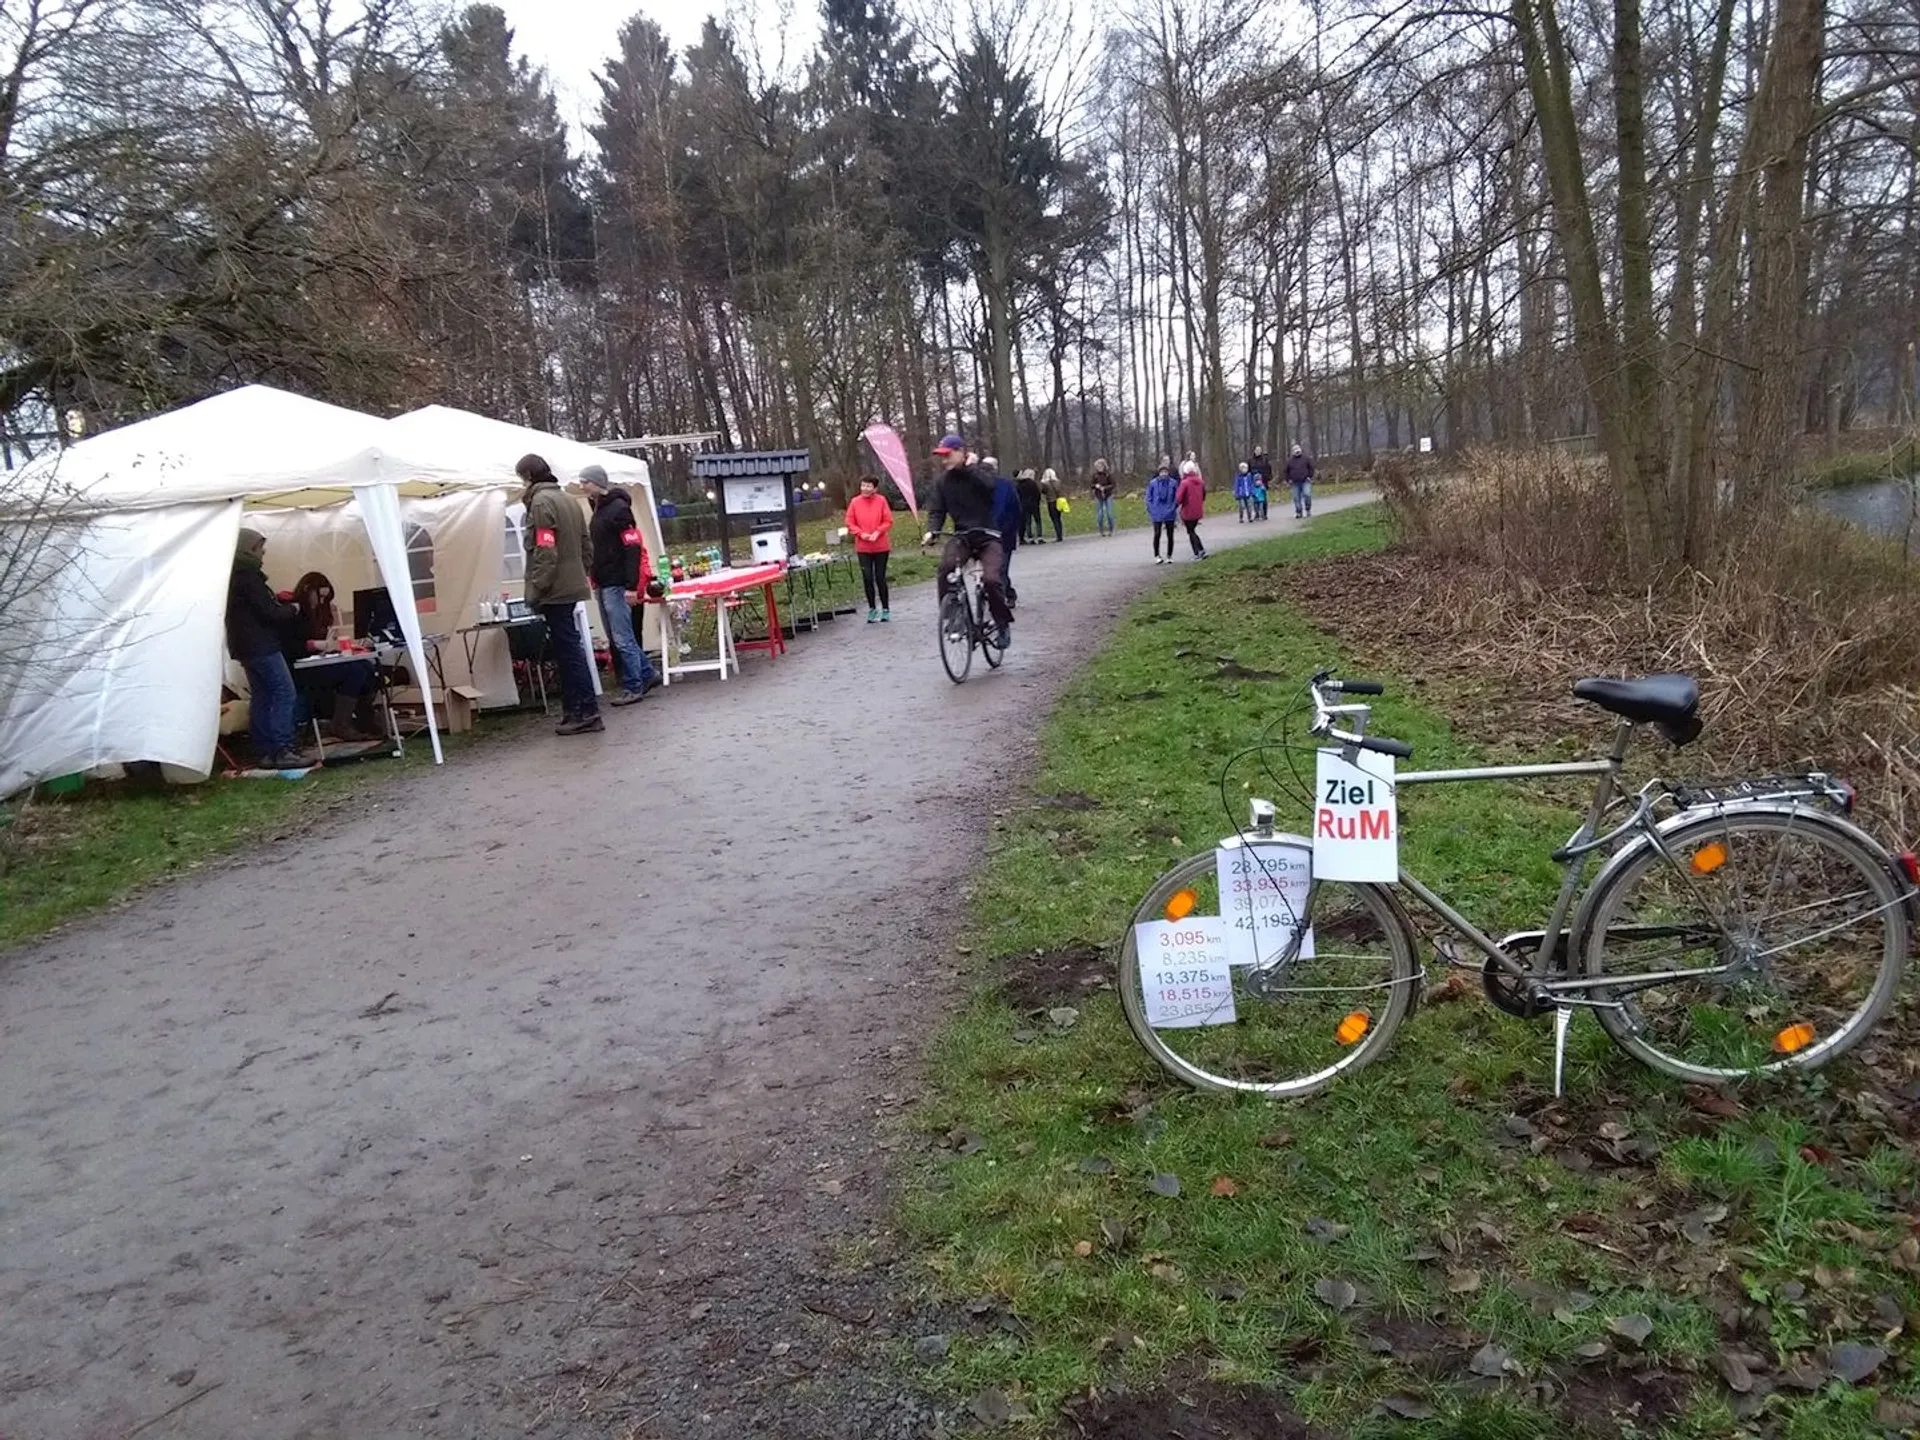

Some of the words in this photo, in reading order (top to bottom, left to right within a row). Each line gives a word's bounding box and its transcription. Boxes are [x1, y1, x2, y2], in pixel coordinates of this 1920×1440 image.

[1325, 779, 1374, 805] Ziel
[1318, 808, 1390, 840] RuM
[1234, 912, 1290, 931] 42,195
[1160, 930, 1205, 948] 3,095
[1206, 935, 1222, 944] km
[1162, 950, 1207, 967] 8,235
[1210, 973, 1227, 982] km
